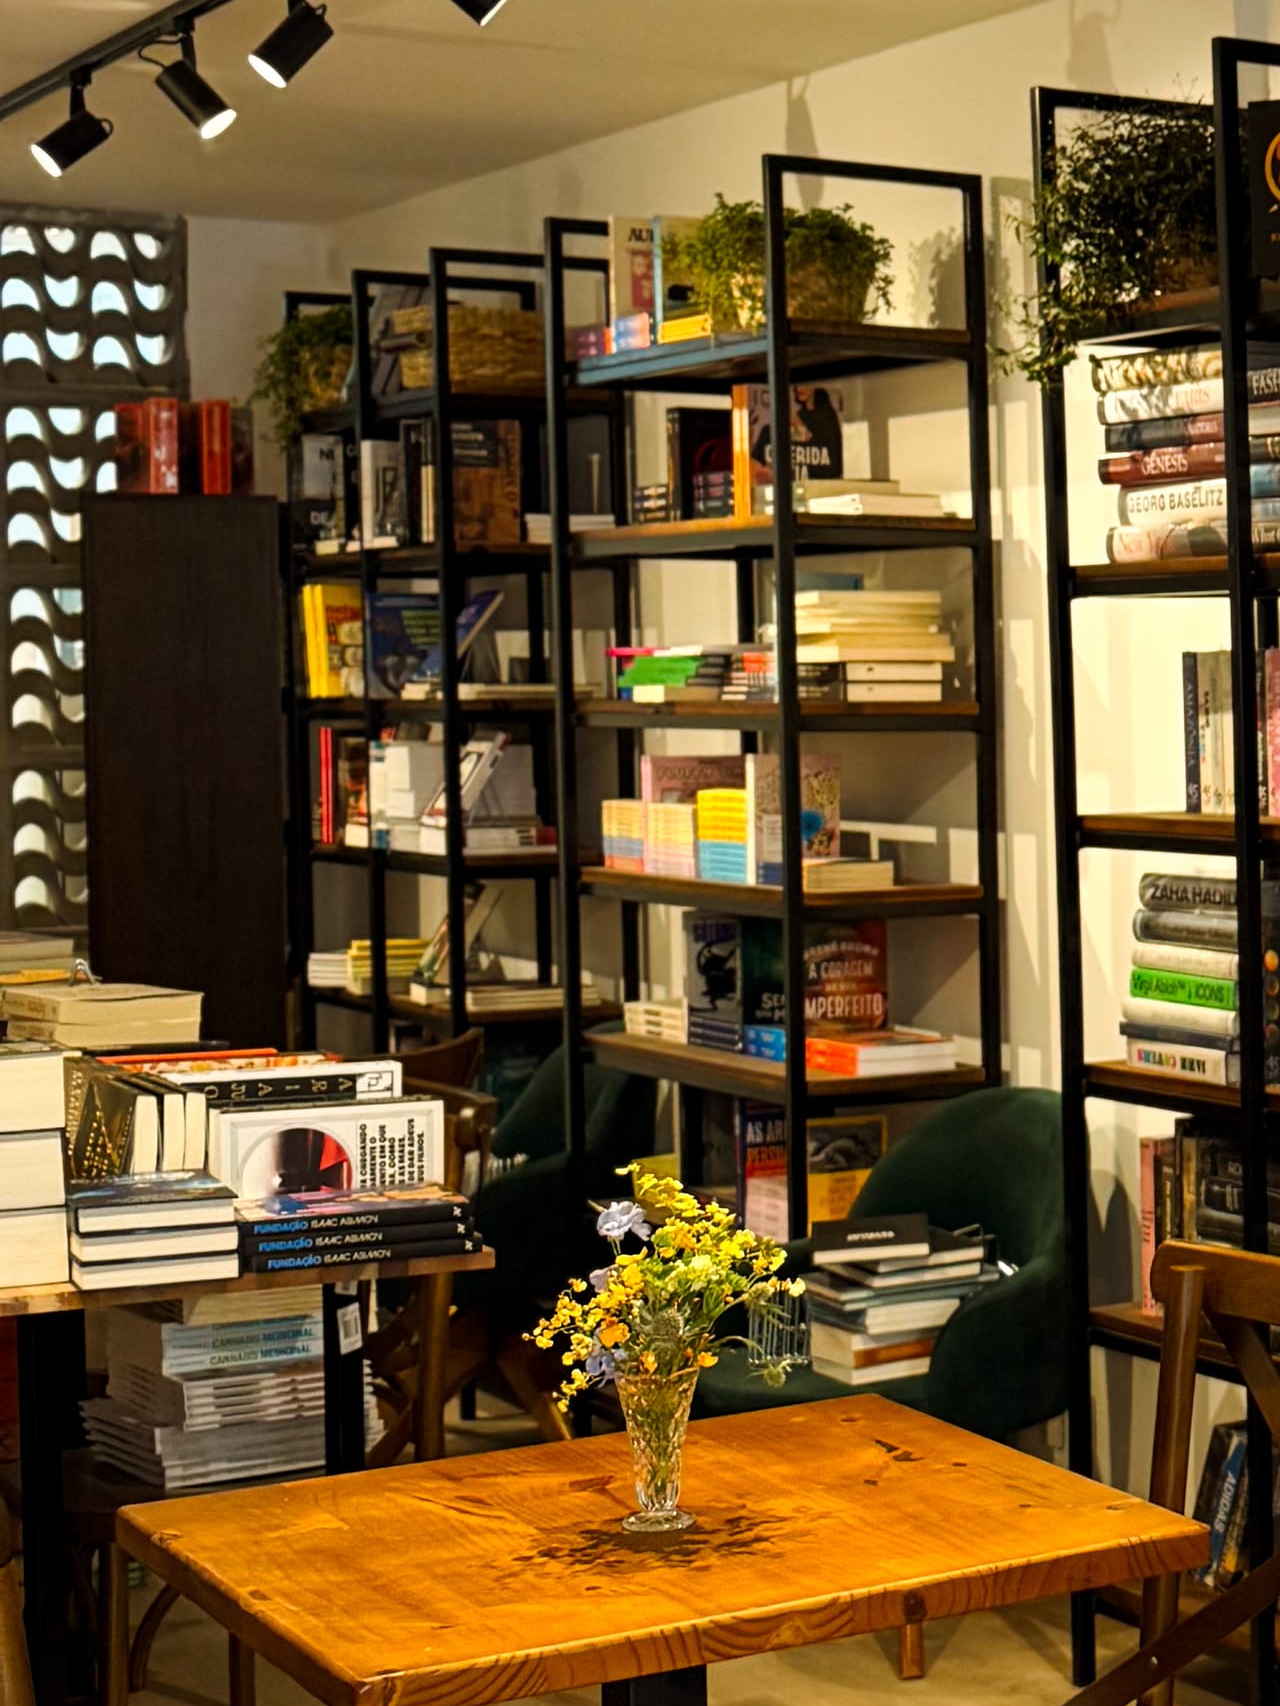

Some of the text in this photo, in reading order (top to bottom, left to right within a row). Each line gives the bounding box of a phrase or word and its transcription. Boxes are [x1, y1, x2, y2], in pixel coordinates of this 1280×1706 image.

[1129, 489, 1223, 513] GEORG BASELITZ
[1213, 1471, 1236, 1534] ADIDAS
